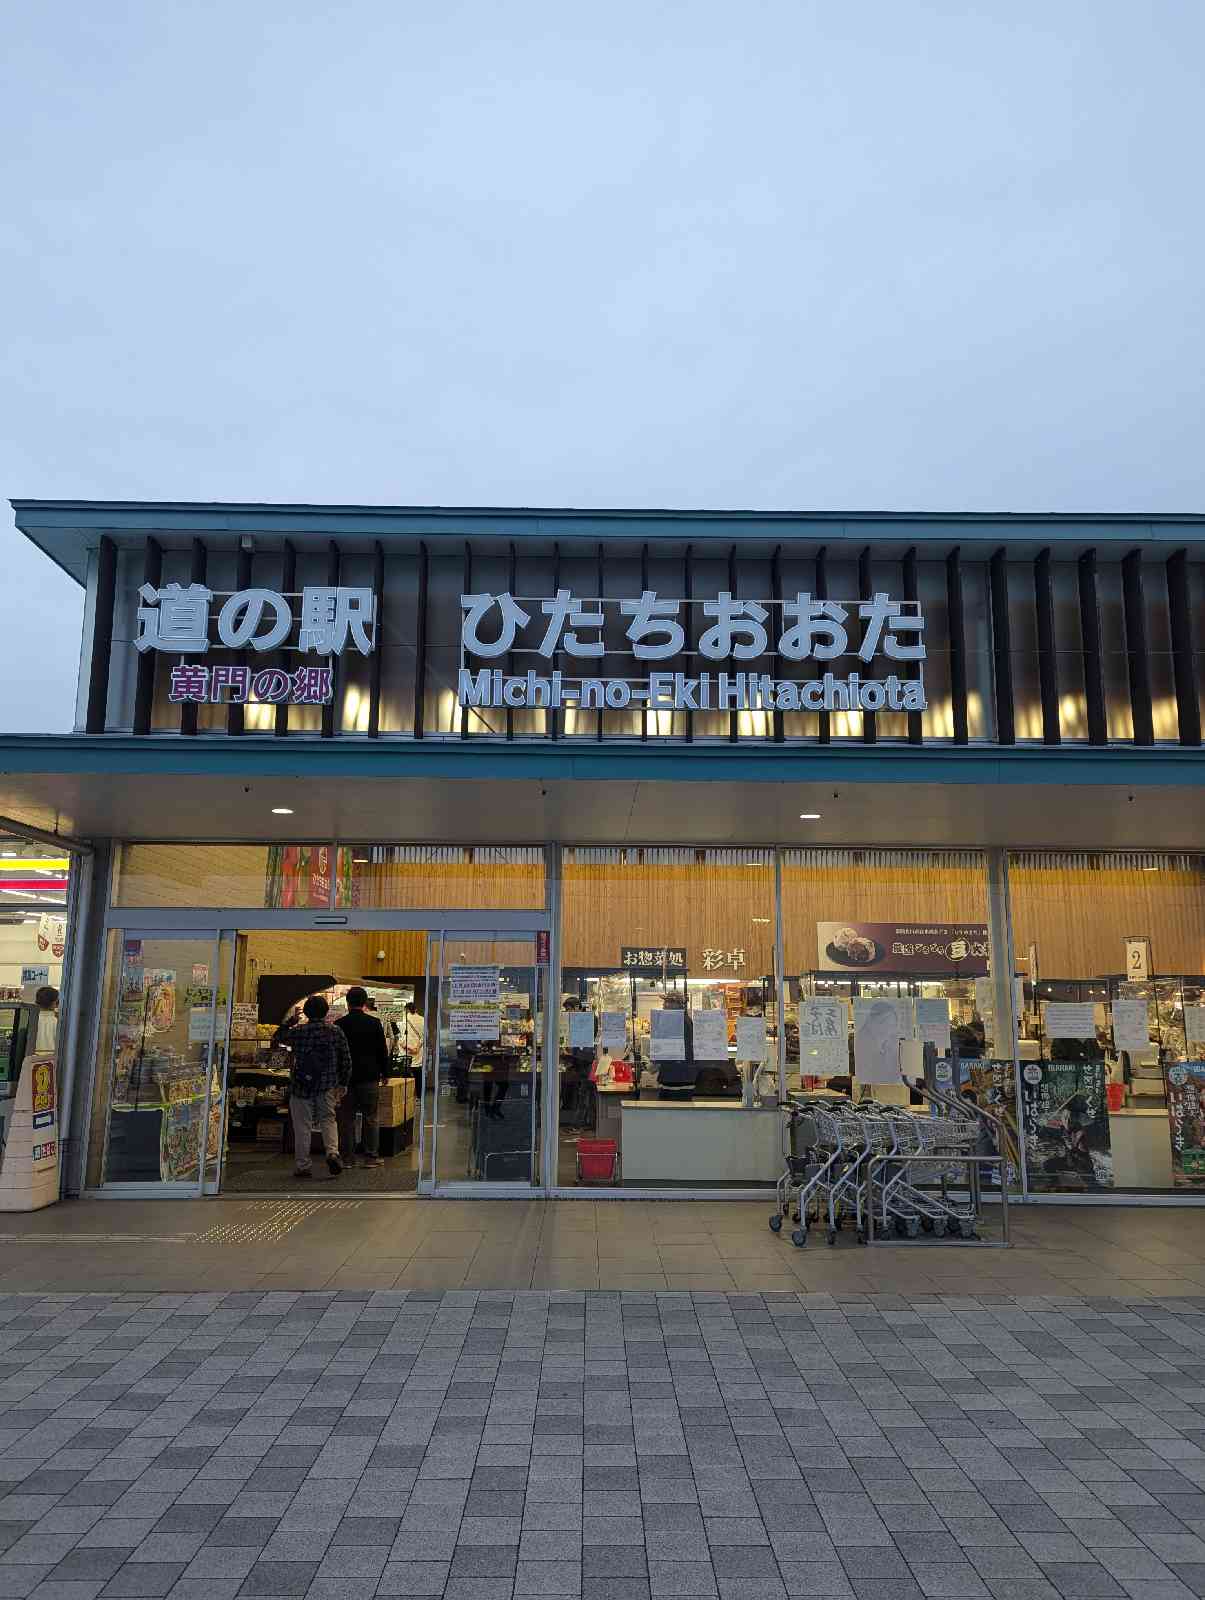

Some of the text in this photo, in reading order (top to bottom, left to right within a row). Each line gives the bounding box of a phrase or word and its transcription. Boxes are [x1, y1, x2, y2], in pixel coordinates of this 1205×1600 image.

[134, 582, 378, 656] 道の駅
[460, 588, 927, 662] ひたちおおた
[168, 665, 334, 704] 黄門の郷
[458, 668, 928, 712] Michi-no-Eki Hitachiota
[702, 948, 746, 971] 彩卓
[1131, 950, 1142, 969] 2
